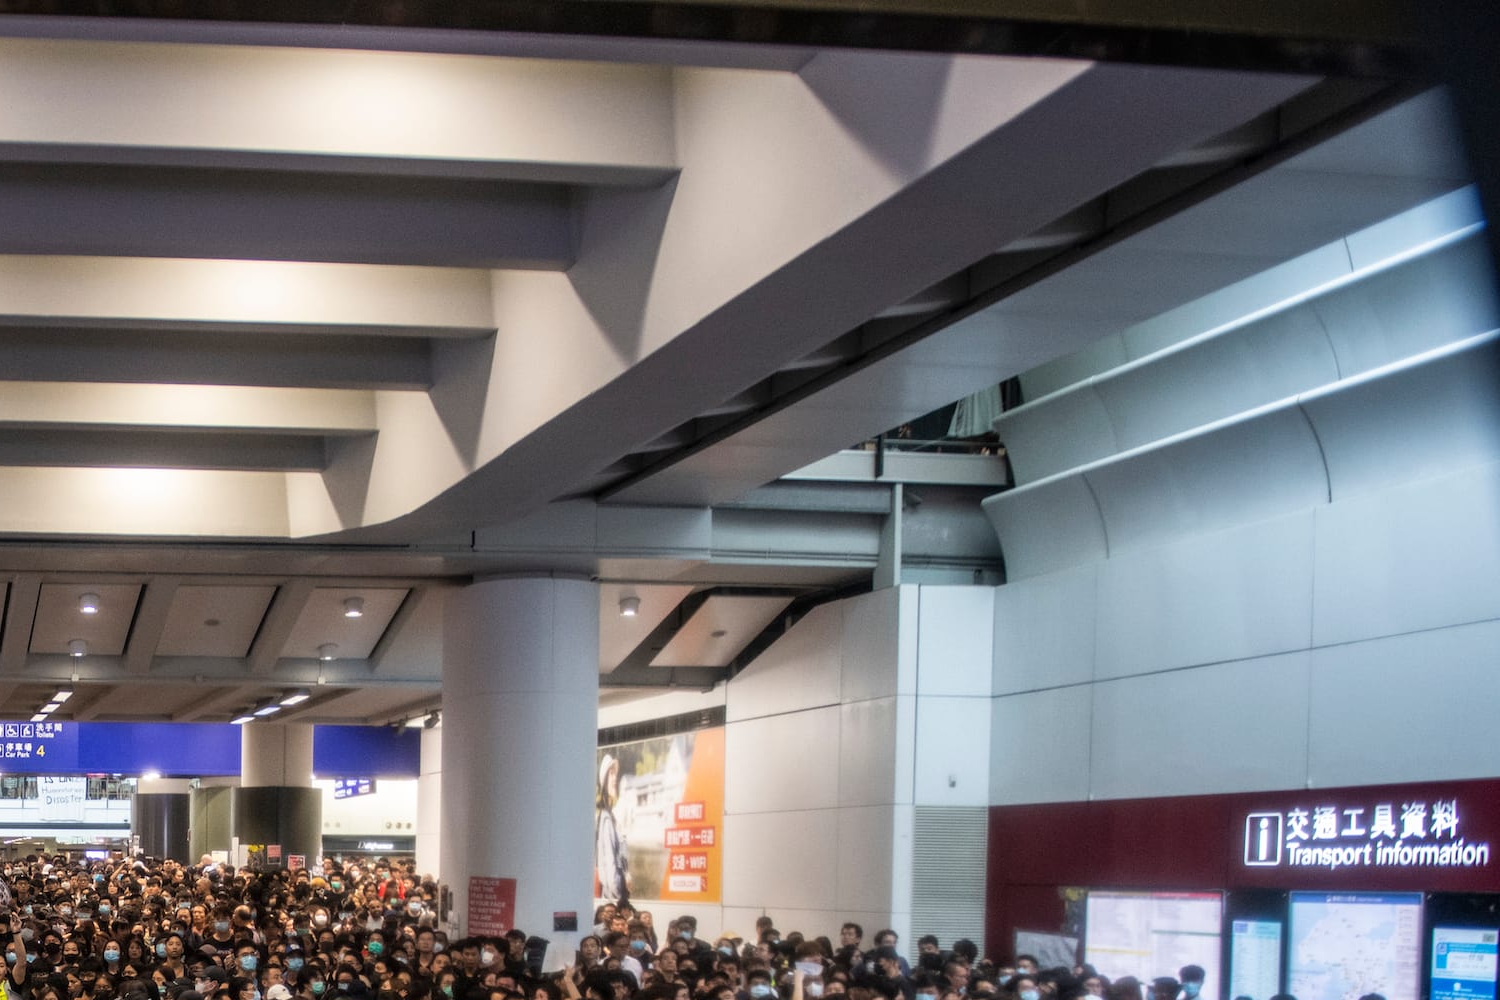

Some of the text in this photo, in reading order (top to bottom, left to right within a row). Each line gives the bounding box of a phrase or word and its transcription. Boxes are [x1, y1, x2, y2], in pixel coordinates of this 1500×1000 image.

[36, 745, 45, 757] 4
[1286, 798, 1460, 840] 交通工具資料
[1286, 837, 1490, 871] Transport information
